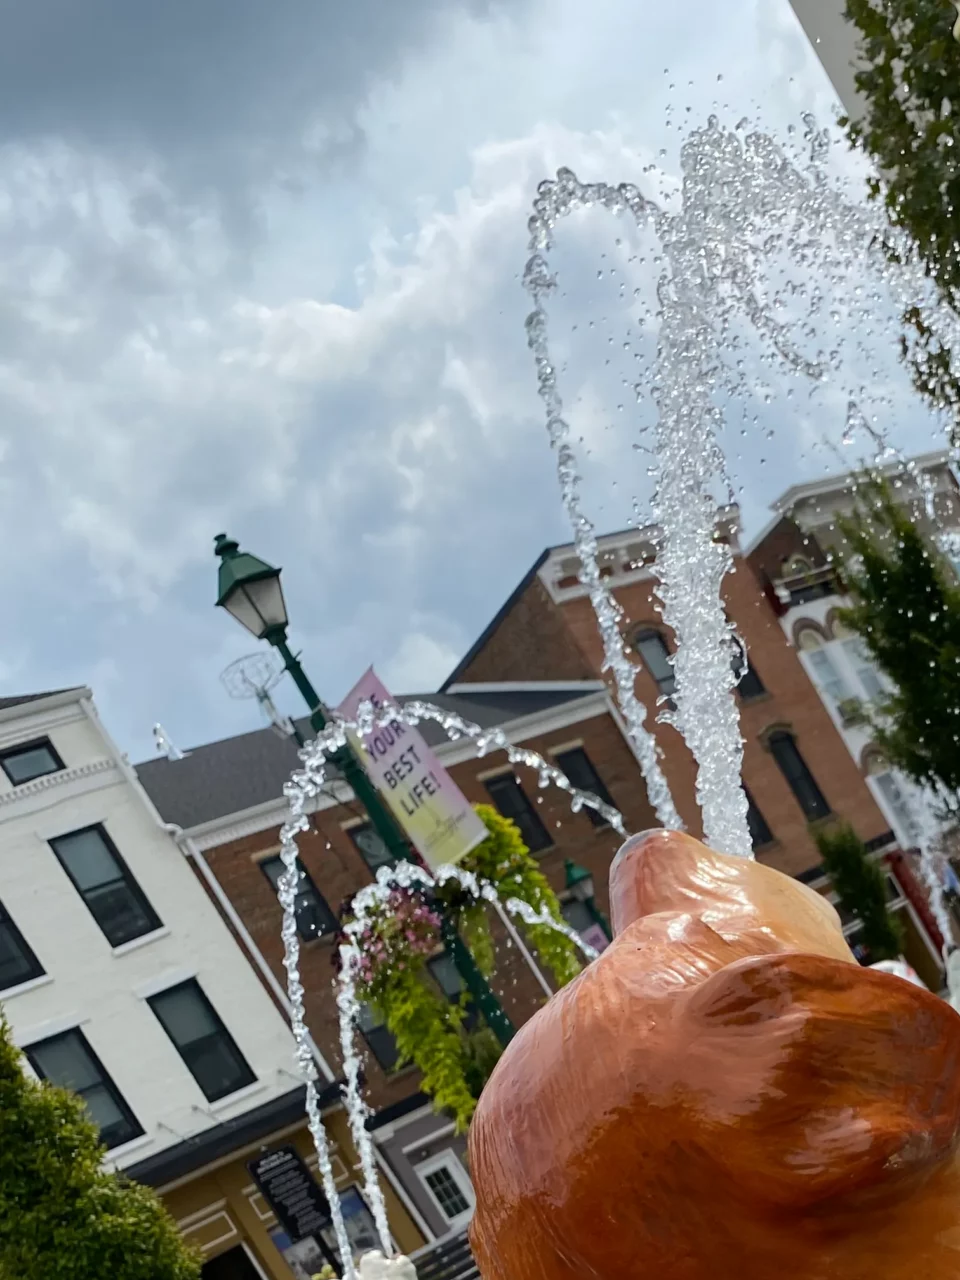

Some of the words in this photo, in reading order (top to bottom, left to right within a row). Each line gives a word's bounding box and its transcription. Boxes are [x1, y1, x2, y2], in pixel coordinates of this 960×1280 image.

[367, 719, 406, 763] YOUR
[383, 744, 421, 790] BEST
[400, 771, 441, 817] LIFE!
